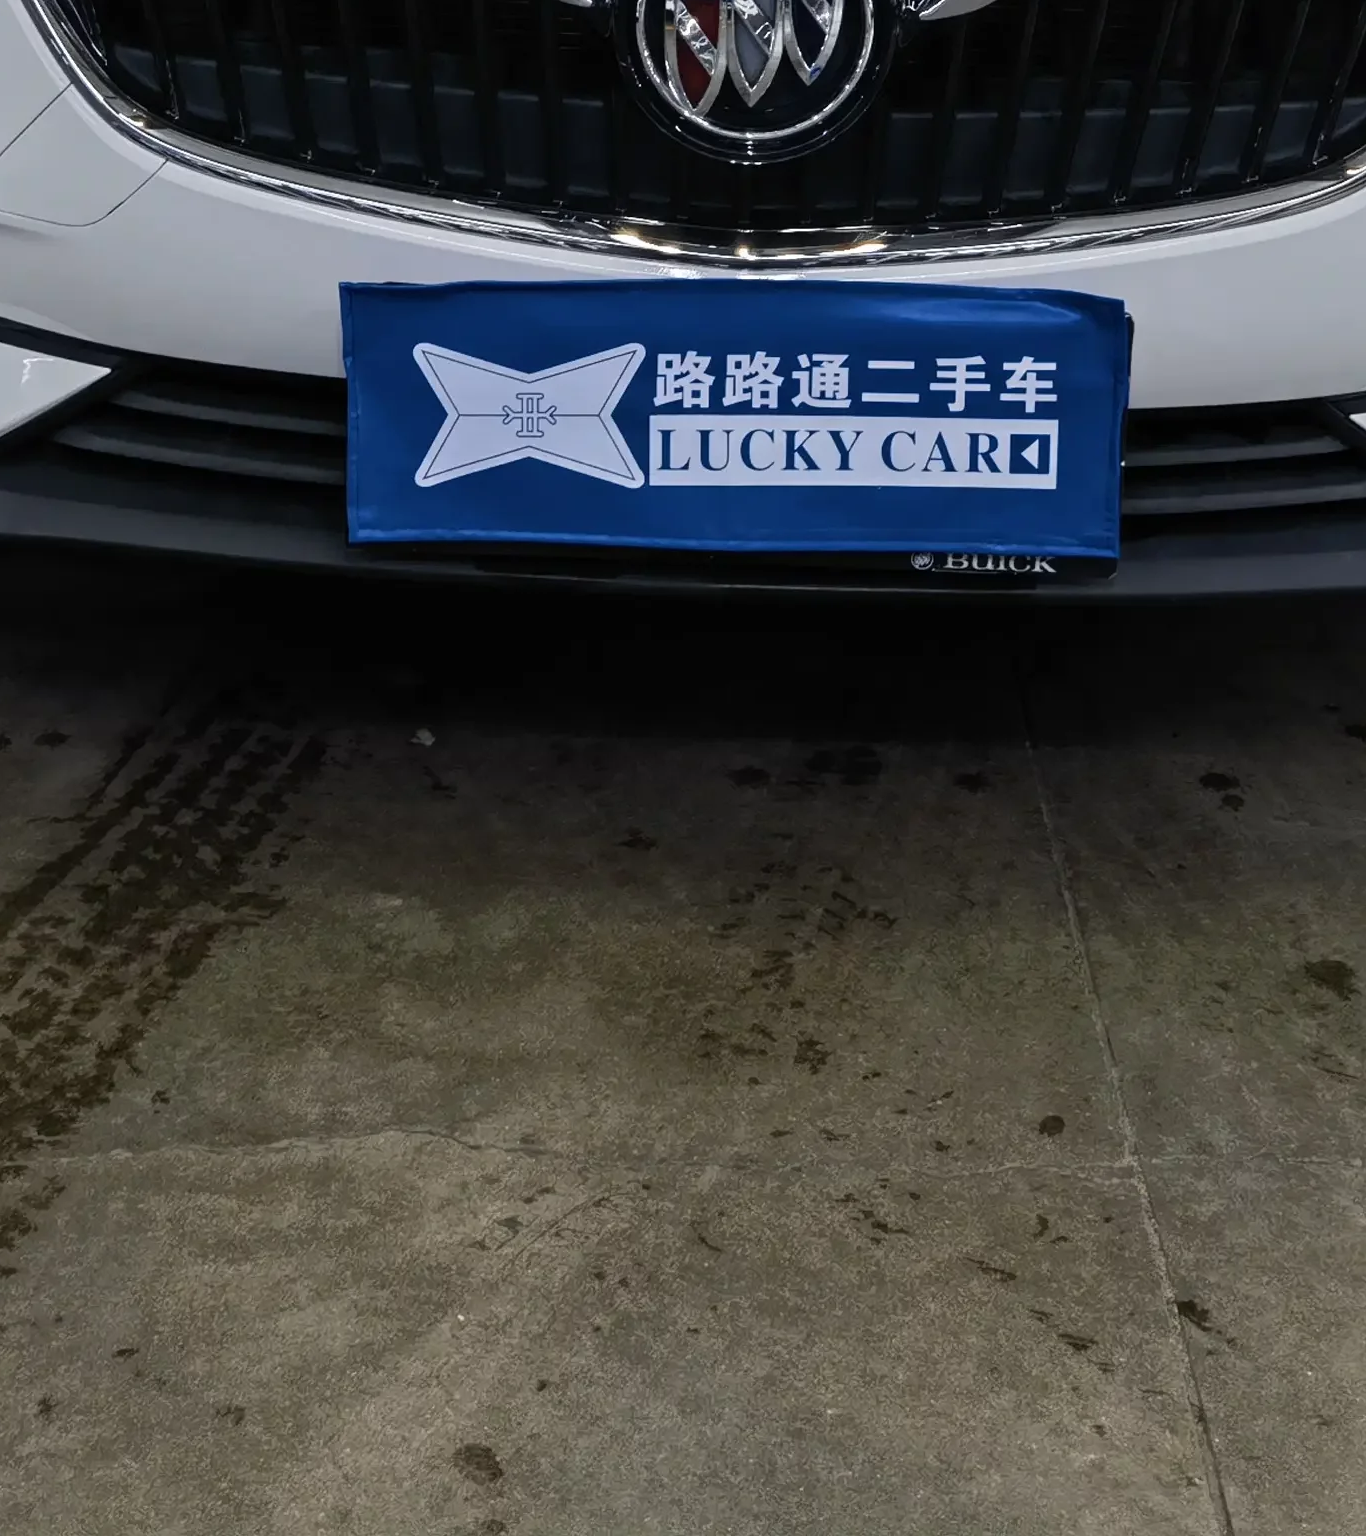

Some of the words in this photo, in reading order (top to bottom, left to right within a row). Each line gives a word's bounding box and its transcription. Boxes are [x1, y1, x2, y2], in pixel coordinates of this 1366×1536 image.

[653, 350, 1057, 413] 路路通二手车
[656, 428, 864, 472] LUCKY
[879, 430, 1004, 475] CAR
